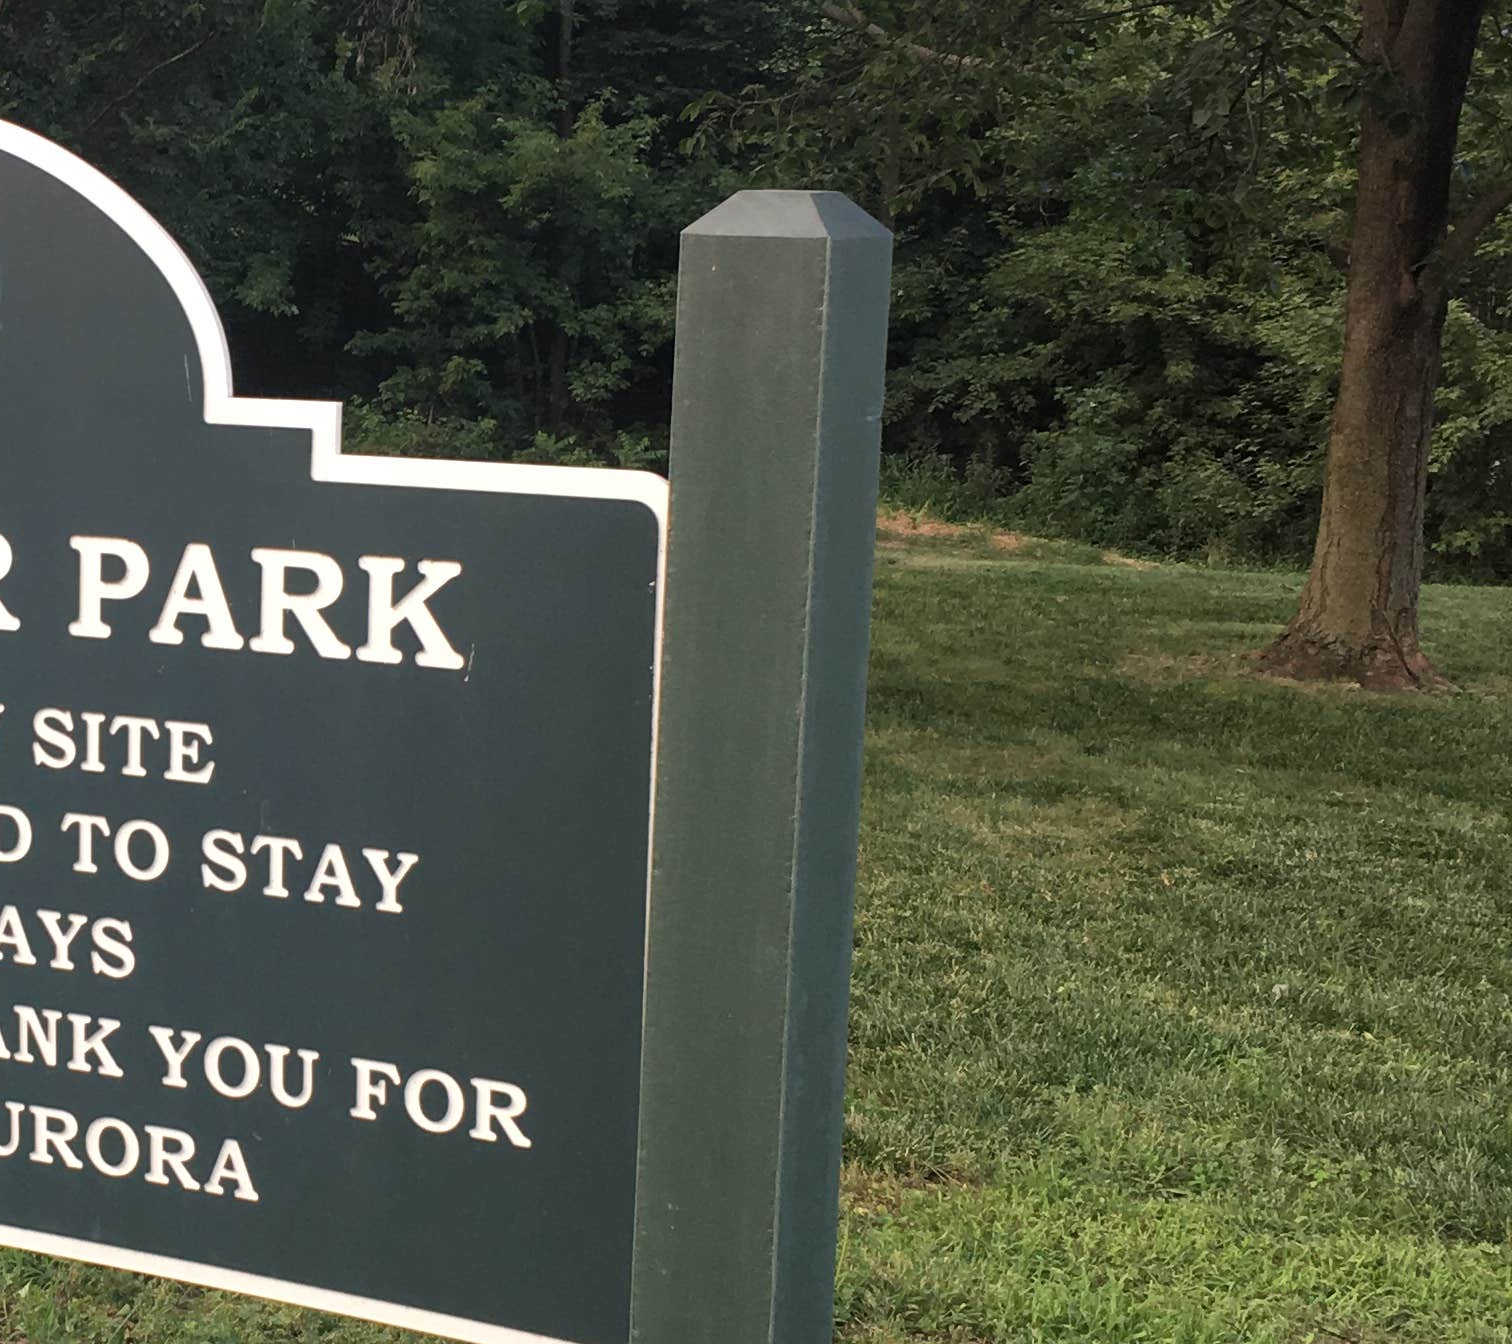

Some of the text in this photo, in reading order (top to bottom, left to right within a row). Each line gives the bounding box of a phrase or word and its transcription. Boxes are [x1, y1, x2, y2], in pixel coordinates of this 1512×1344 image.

[68, 535, 465, 670] PARK
[32, 708, 216, 784] SITE
[60, 812, 170, 881] TO
[201, 829, 419, 914] STAY
[148, 1025, 320, 1108] YOU
[349, 1057, 532, 1148] FOR
